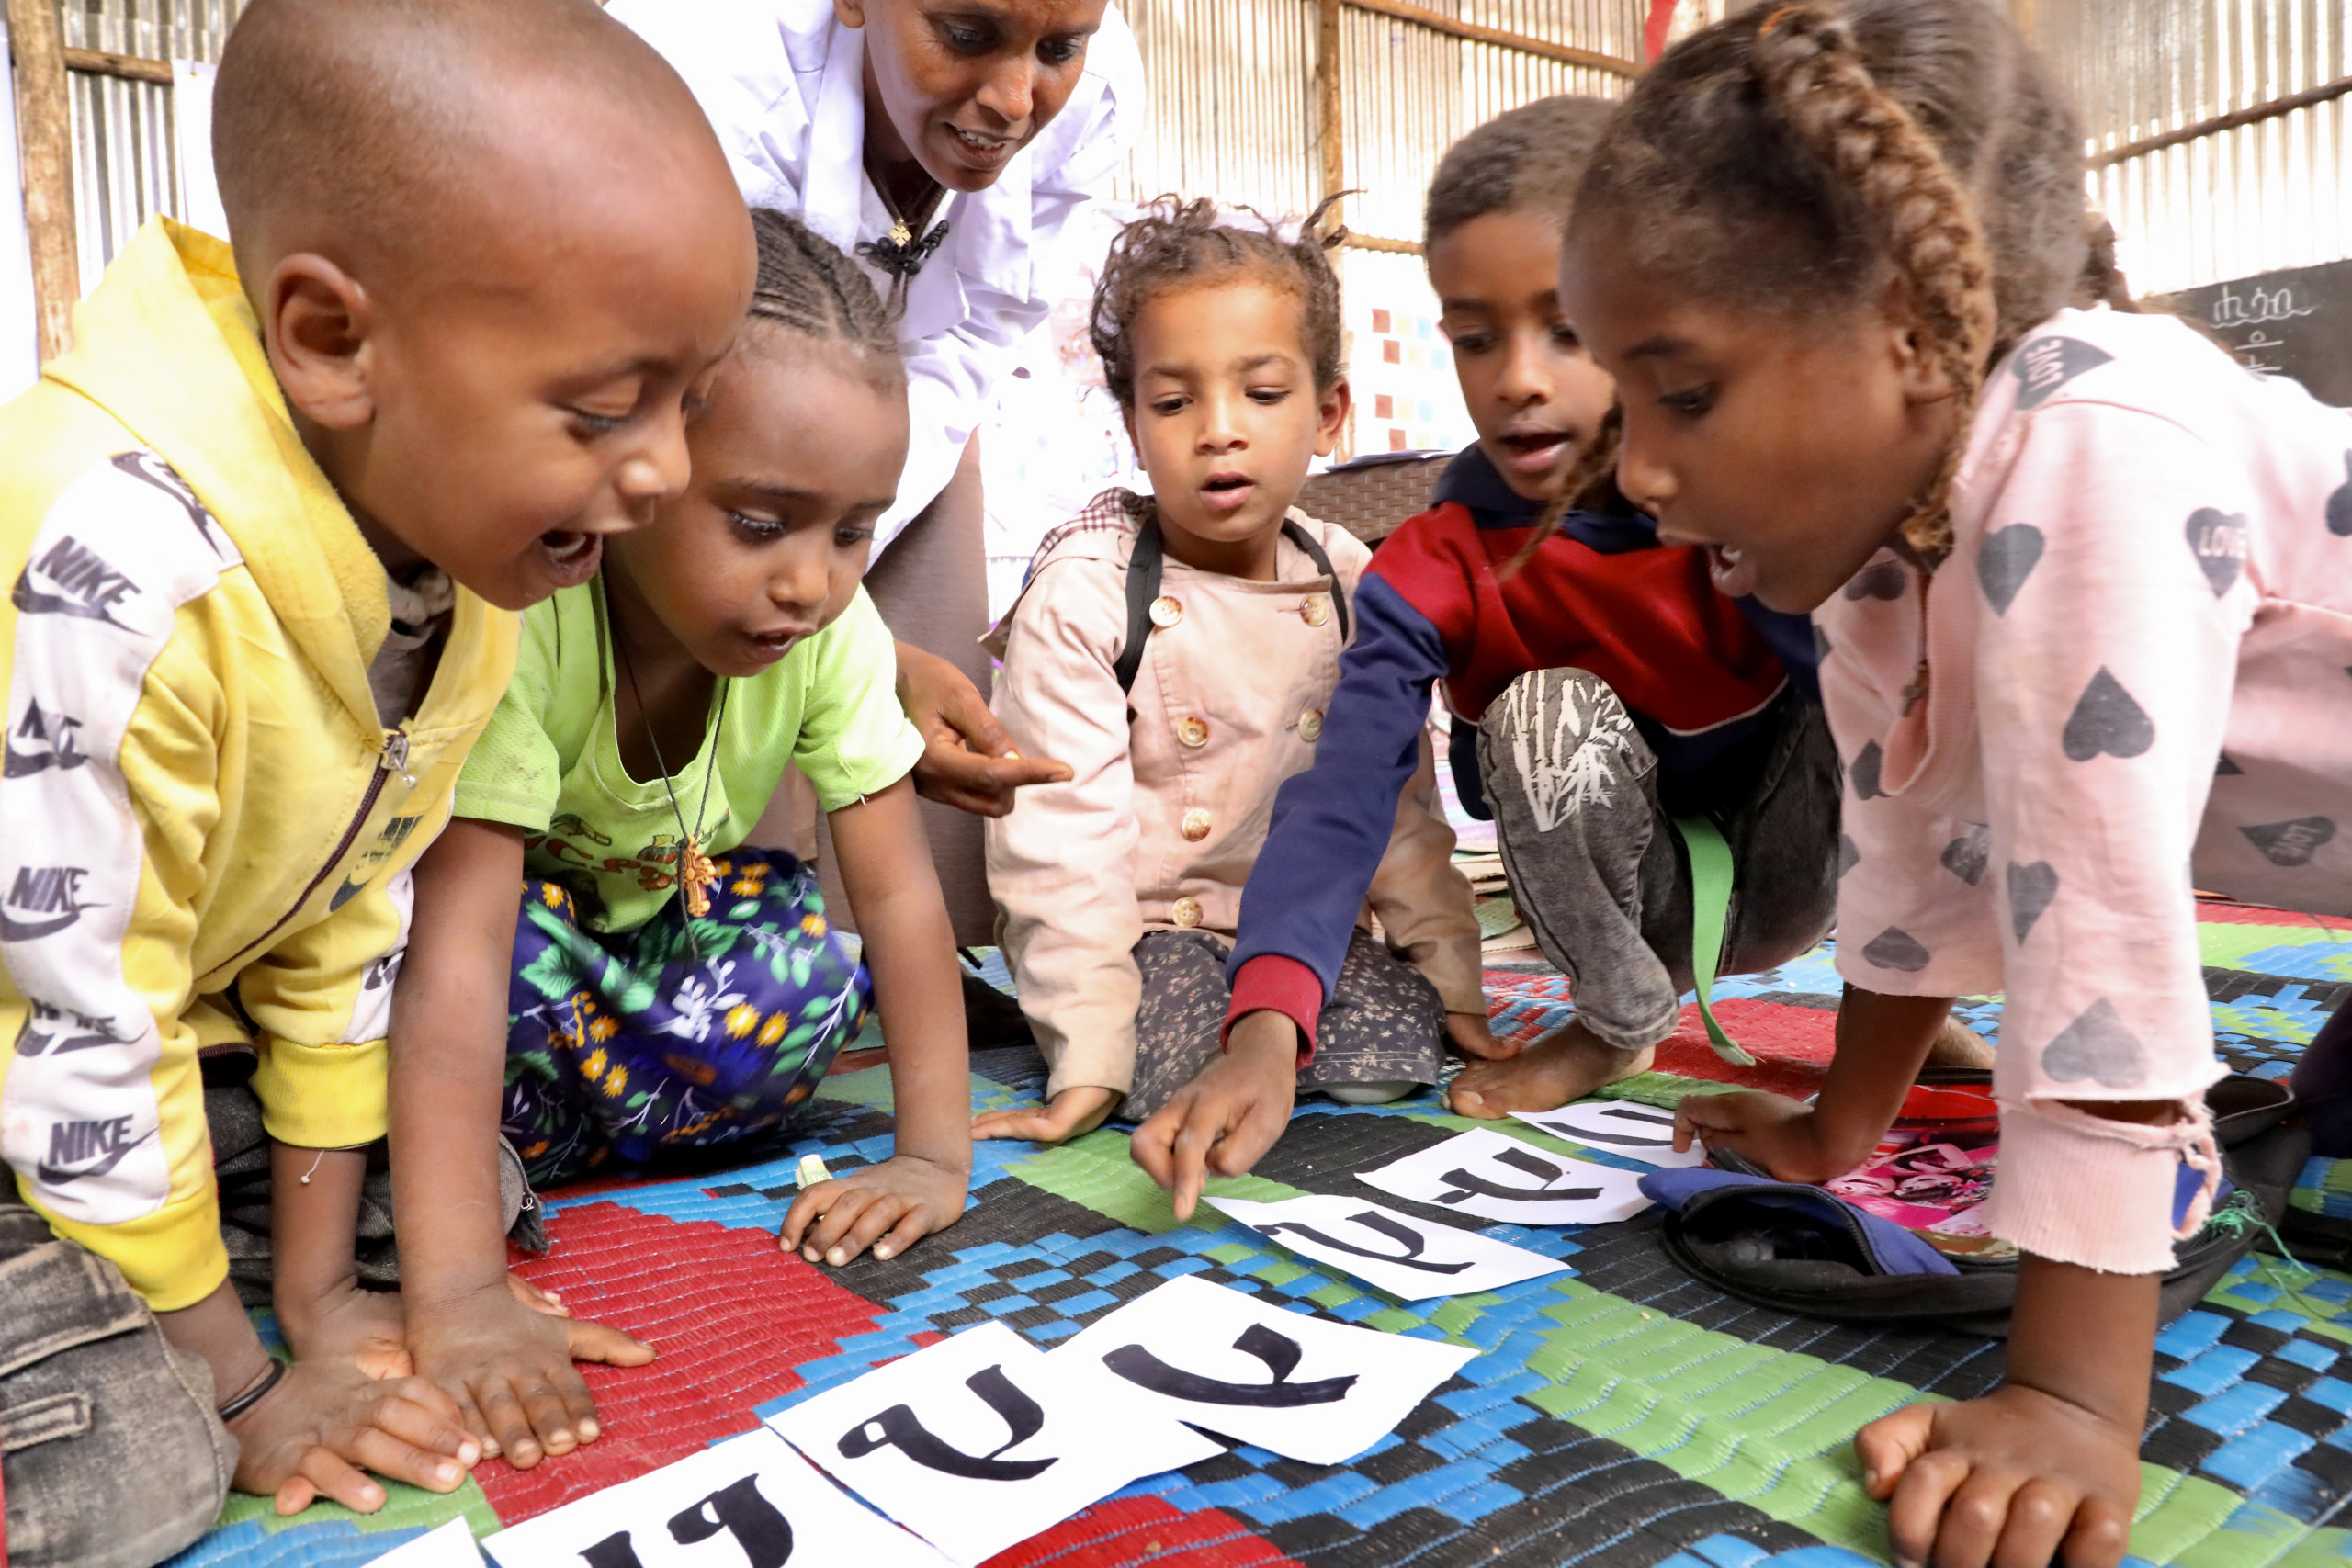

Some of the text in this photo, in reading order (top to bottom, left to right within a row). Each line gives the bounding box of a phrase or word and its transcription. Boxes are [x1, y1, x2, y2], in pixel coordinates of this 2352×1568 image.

[2024, 340, 2064, 393] LOVE
[2198, 524, 2247, 558] LOVE
[35, 534, 142, 616] NIKE
[7, 866, 89, 913] NIKE
[49, 1113, 134, 1166] NIKE
